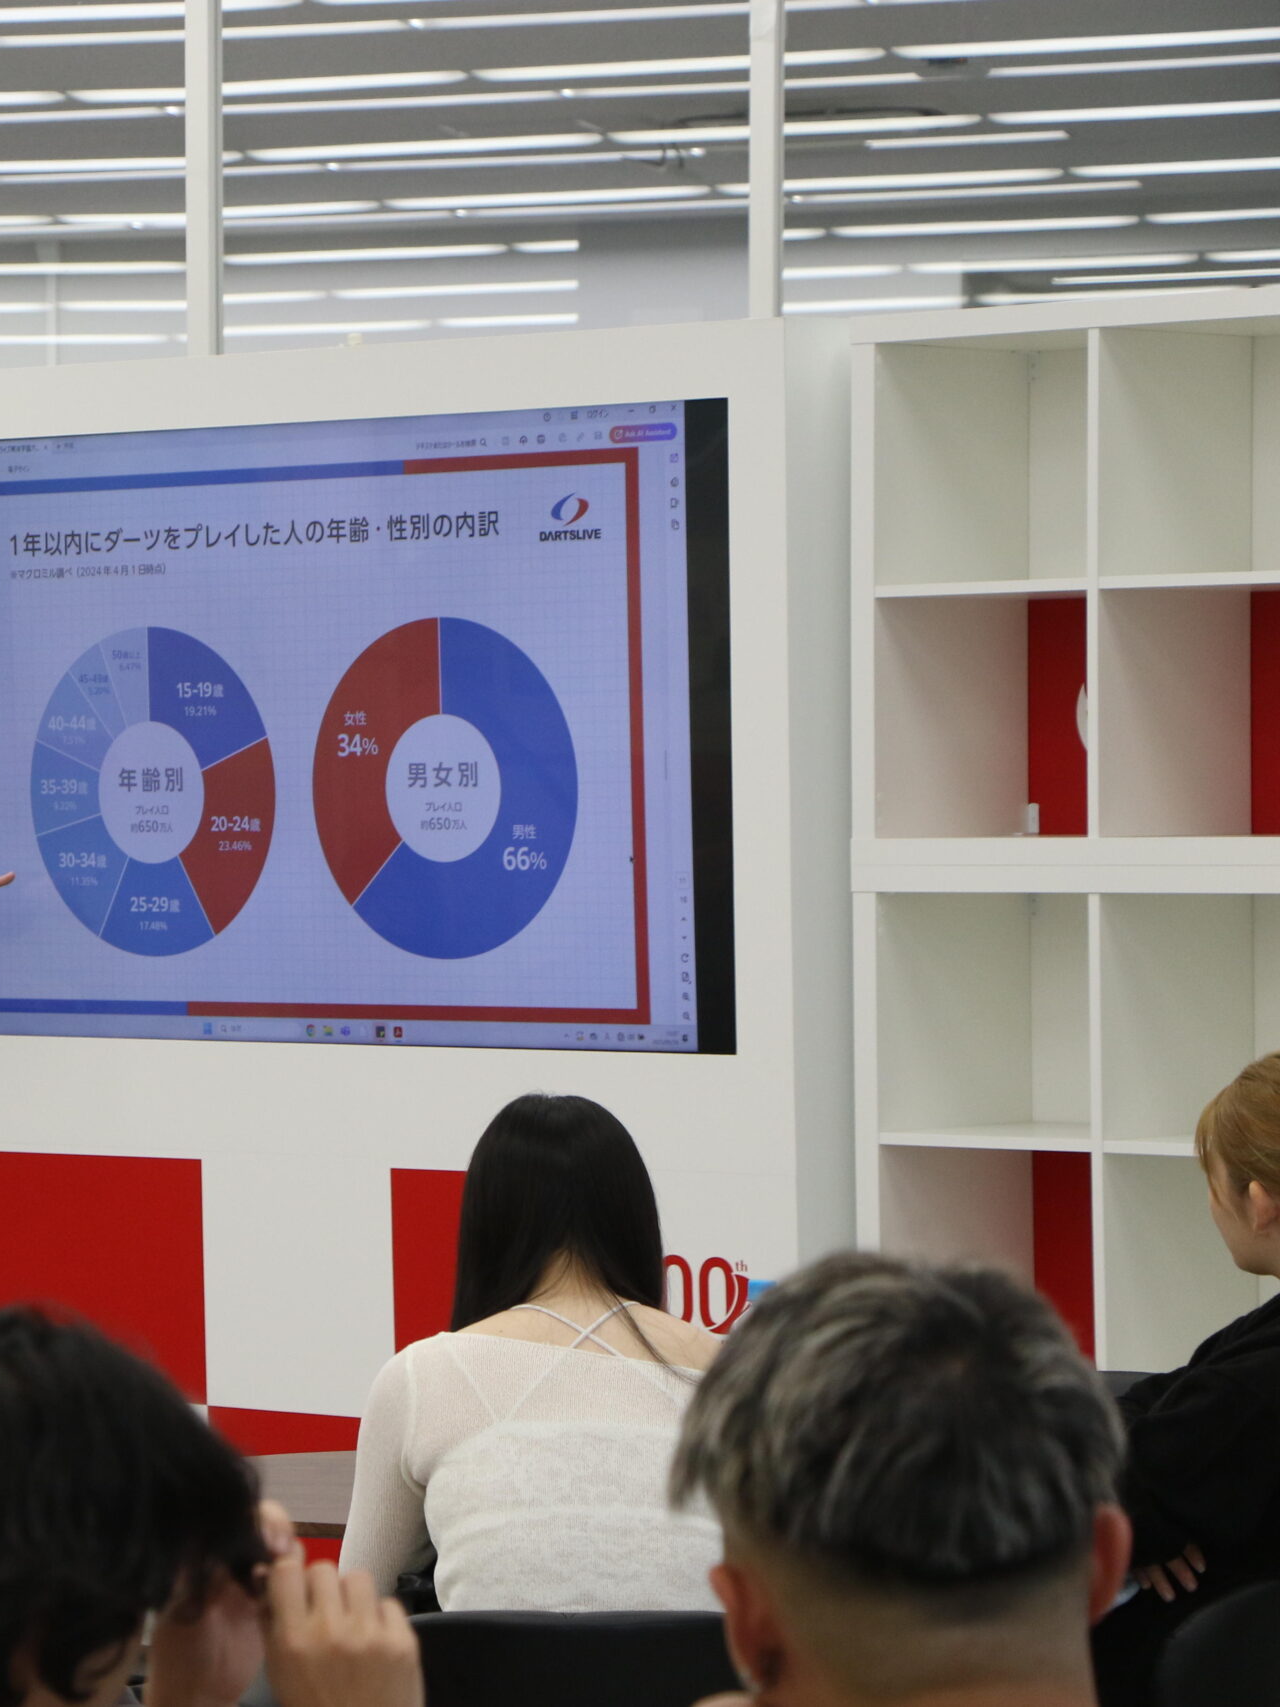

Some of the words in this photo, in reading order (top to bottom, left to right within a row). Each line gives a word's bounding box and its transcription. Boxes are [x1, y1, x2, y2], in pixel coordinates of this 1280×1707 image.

[539, 528, 602, 542] DARTSLIVE
[176, 682, 224, 698] 15-19歳
[184, 706, 217, 717] 19.21%
[344, 711, 368, 727] 女性
[48, 715, 97, 732] 40-44歳
[337, 733, 379, 758] 34%
[118, 767, 184, 793] 年齢別
[407, 761, 479, 789] 男女別
[40, 779, 88, 795] 35-39歳
[135, 805, 169, 816] プレイ人口
[425, 802, 463, 813] プレイ人口
[130, 819, 173, 834] 約650万人
[211, 816, 261, 832] 20-24歳
[420, 816, 468, 831] 約650万人
[512, 823, 537, 840] 男性
[218, 840, 253, 852] 23.46%
[58, 852, 107, 868] 30-34歳
[503, 846, 548, 871] 66%
[130, 897, 180, 913] 25-29歳
